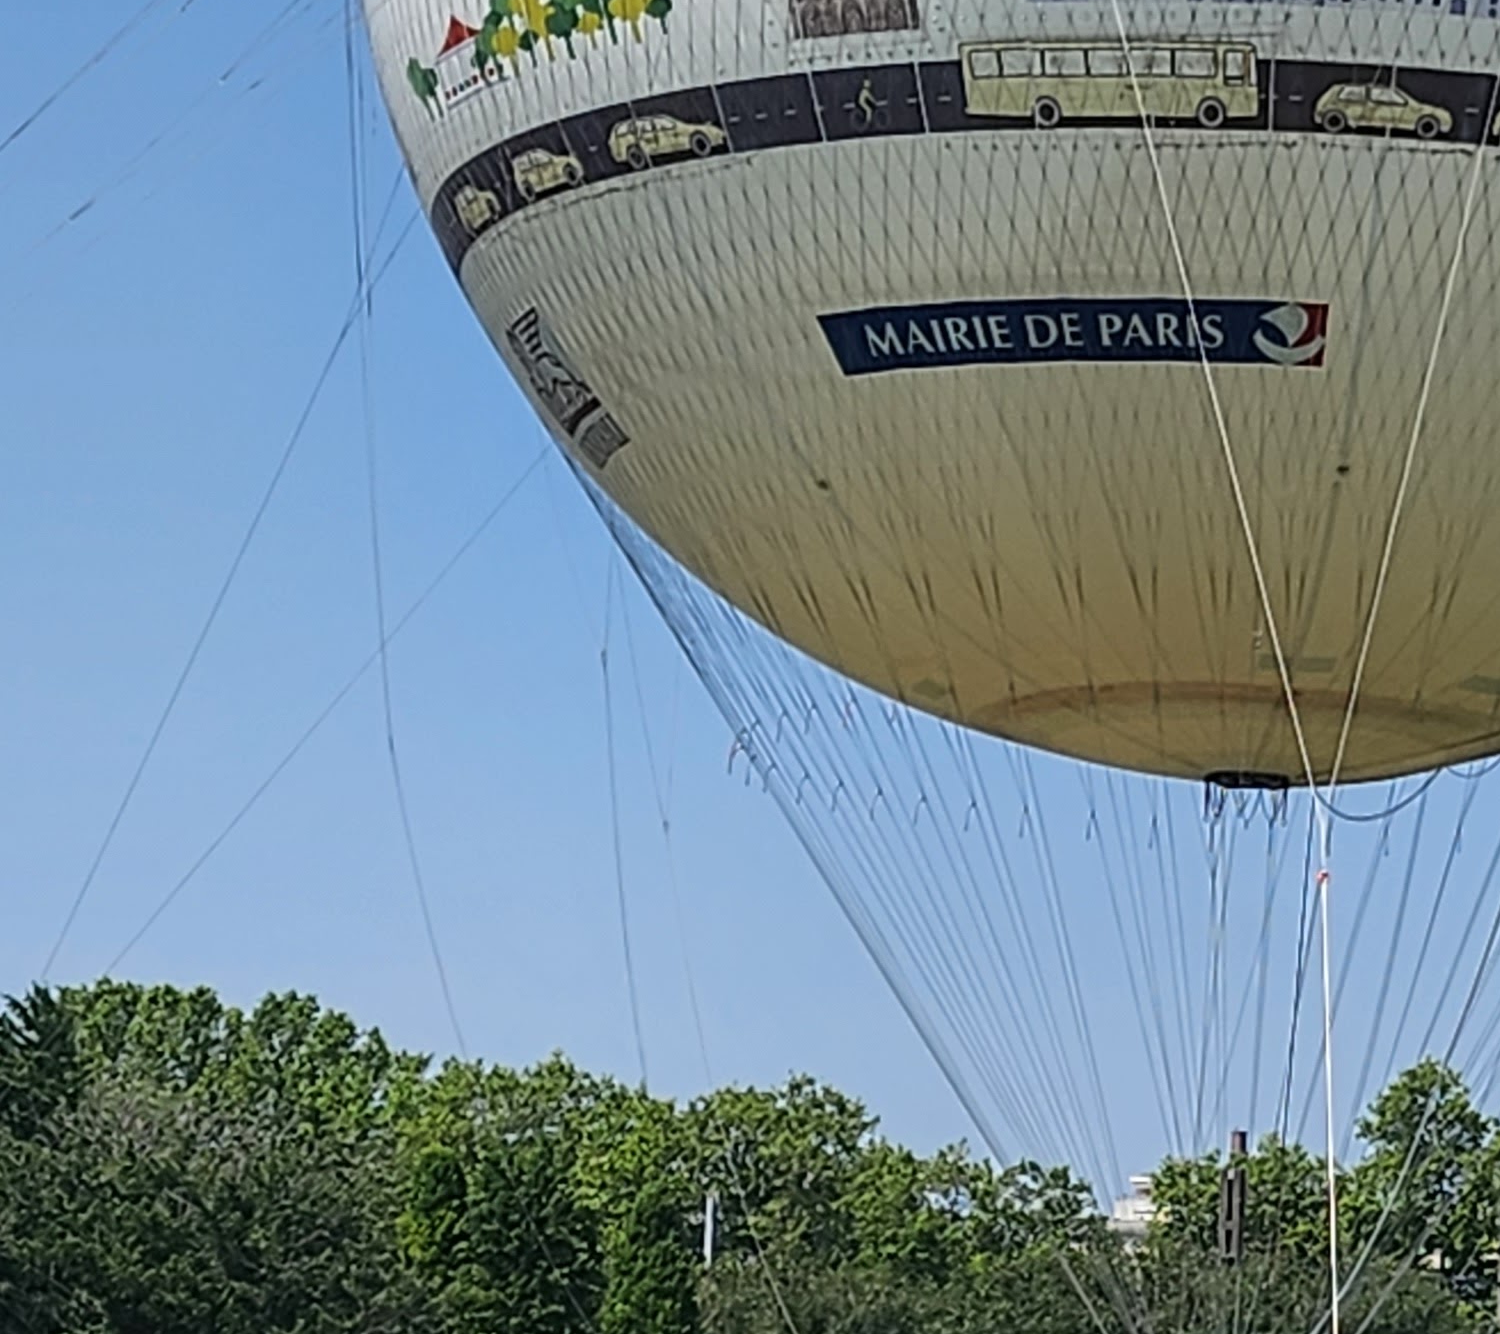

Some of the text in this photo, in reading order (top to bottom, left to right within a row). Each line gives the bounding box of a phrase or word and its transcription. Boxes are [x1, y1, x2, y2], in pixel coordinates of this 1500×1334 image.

[863, 312, 1225, 358] MAIRIE DE PARIS
